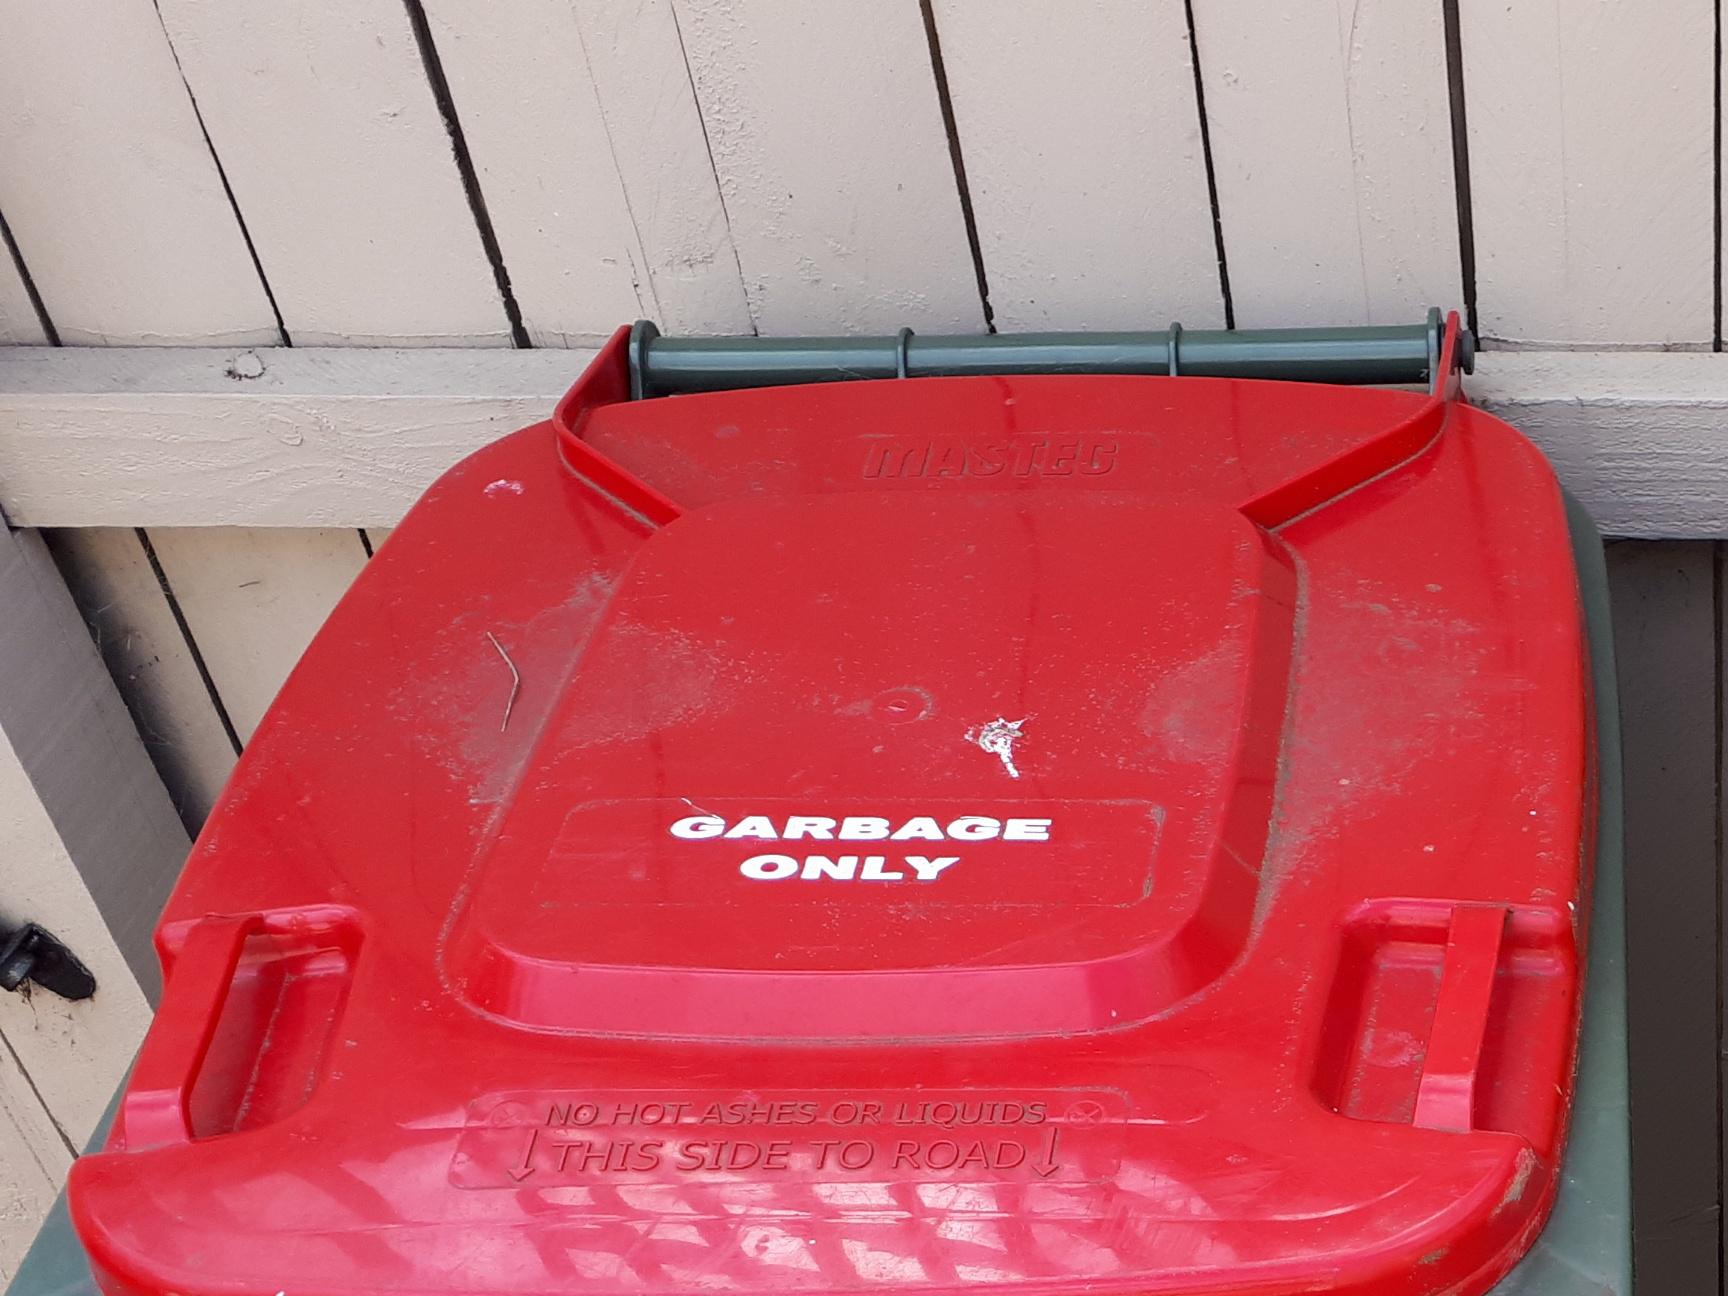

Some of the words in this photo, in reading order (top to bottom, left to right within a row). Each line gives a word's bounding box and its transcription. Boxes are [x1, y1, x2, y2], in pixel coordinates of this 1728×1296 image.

[862, 439, 1120, 479] MASTEC
[669, 815, 1053, 841] GARBAGE
[739, 853, 960, 881] ONLY
[544, 1101, 599, 1127] NO
[610, 1101, 692, 1126] HOT
[698, 1100, 818, 1126] ASHES
[828, 1100, 883, 1125] OR
[895, 1100, 1048, 1129] LIQUIDS
[550, 1139, 663, 1172] THIS
[675, 1139, 793, 1171] SIDE
[809, 1138, 875, 1170] TO
[889, 1138, 1028, 1170] ROAD
